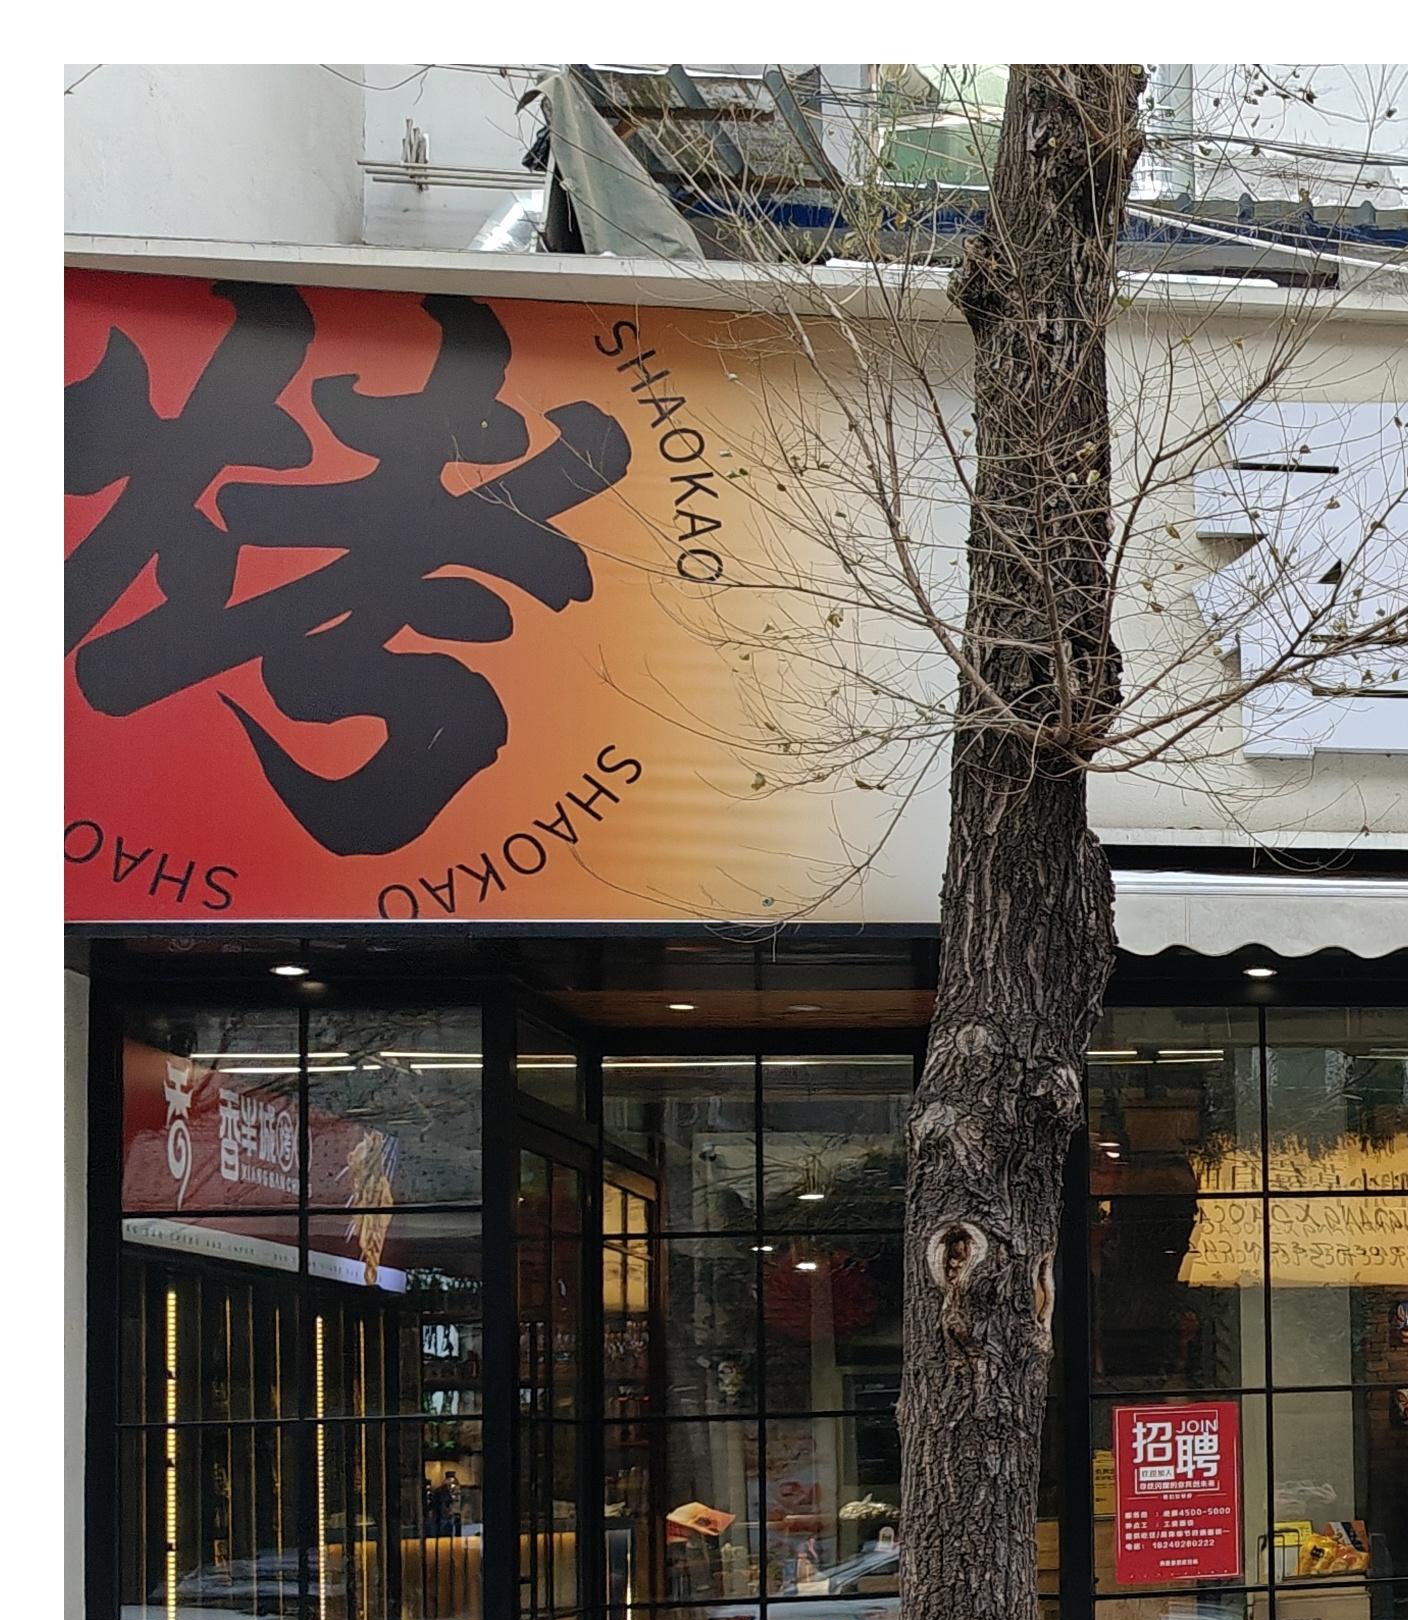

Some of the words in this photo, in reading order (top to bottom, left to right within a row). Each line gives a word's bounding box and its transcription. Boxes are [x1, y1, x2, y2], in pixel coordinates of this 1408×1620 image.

[593, 318, 725, 586] SHAOKAO
[65, 278, 632, 858] 烤
[378, 743, 643, 920] SHAOKAO
[1132, 1421, 1221, 1479] 招聘
[1176, 1419, 1219, 1433] JOIN
